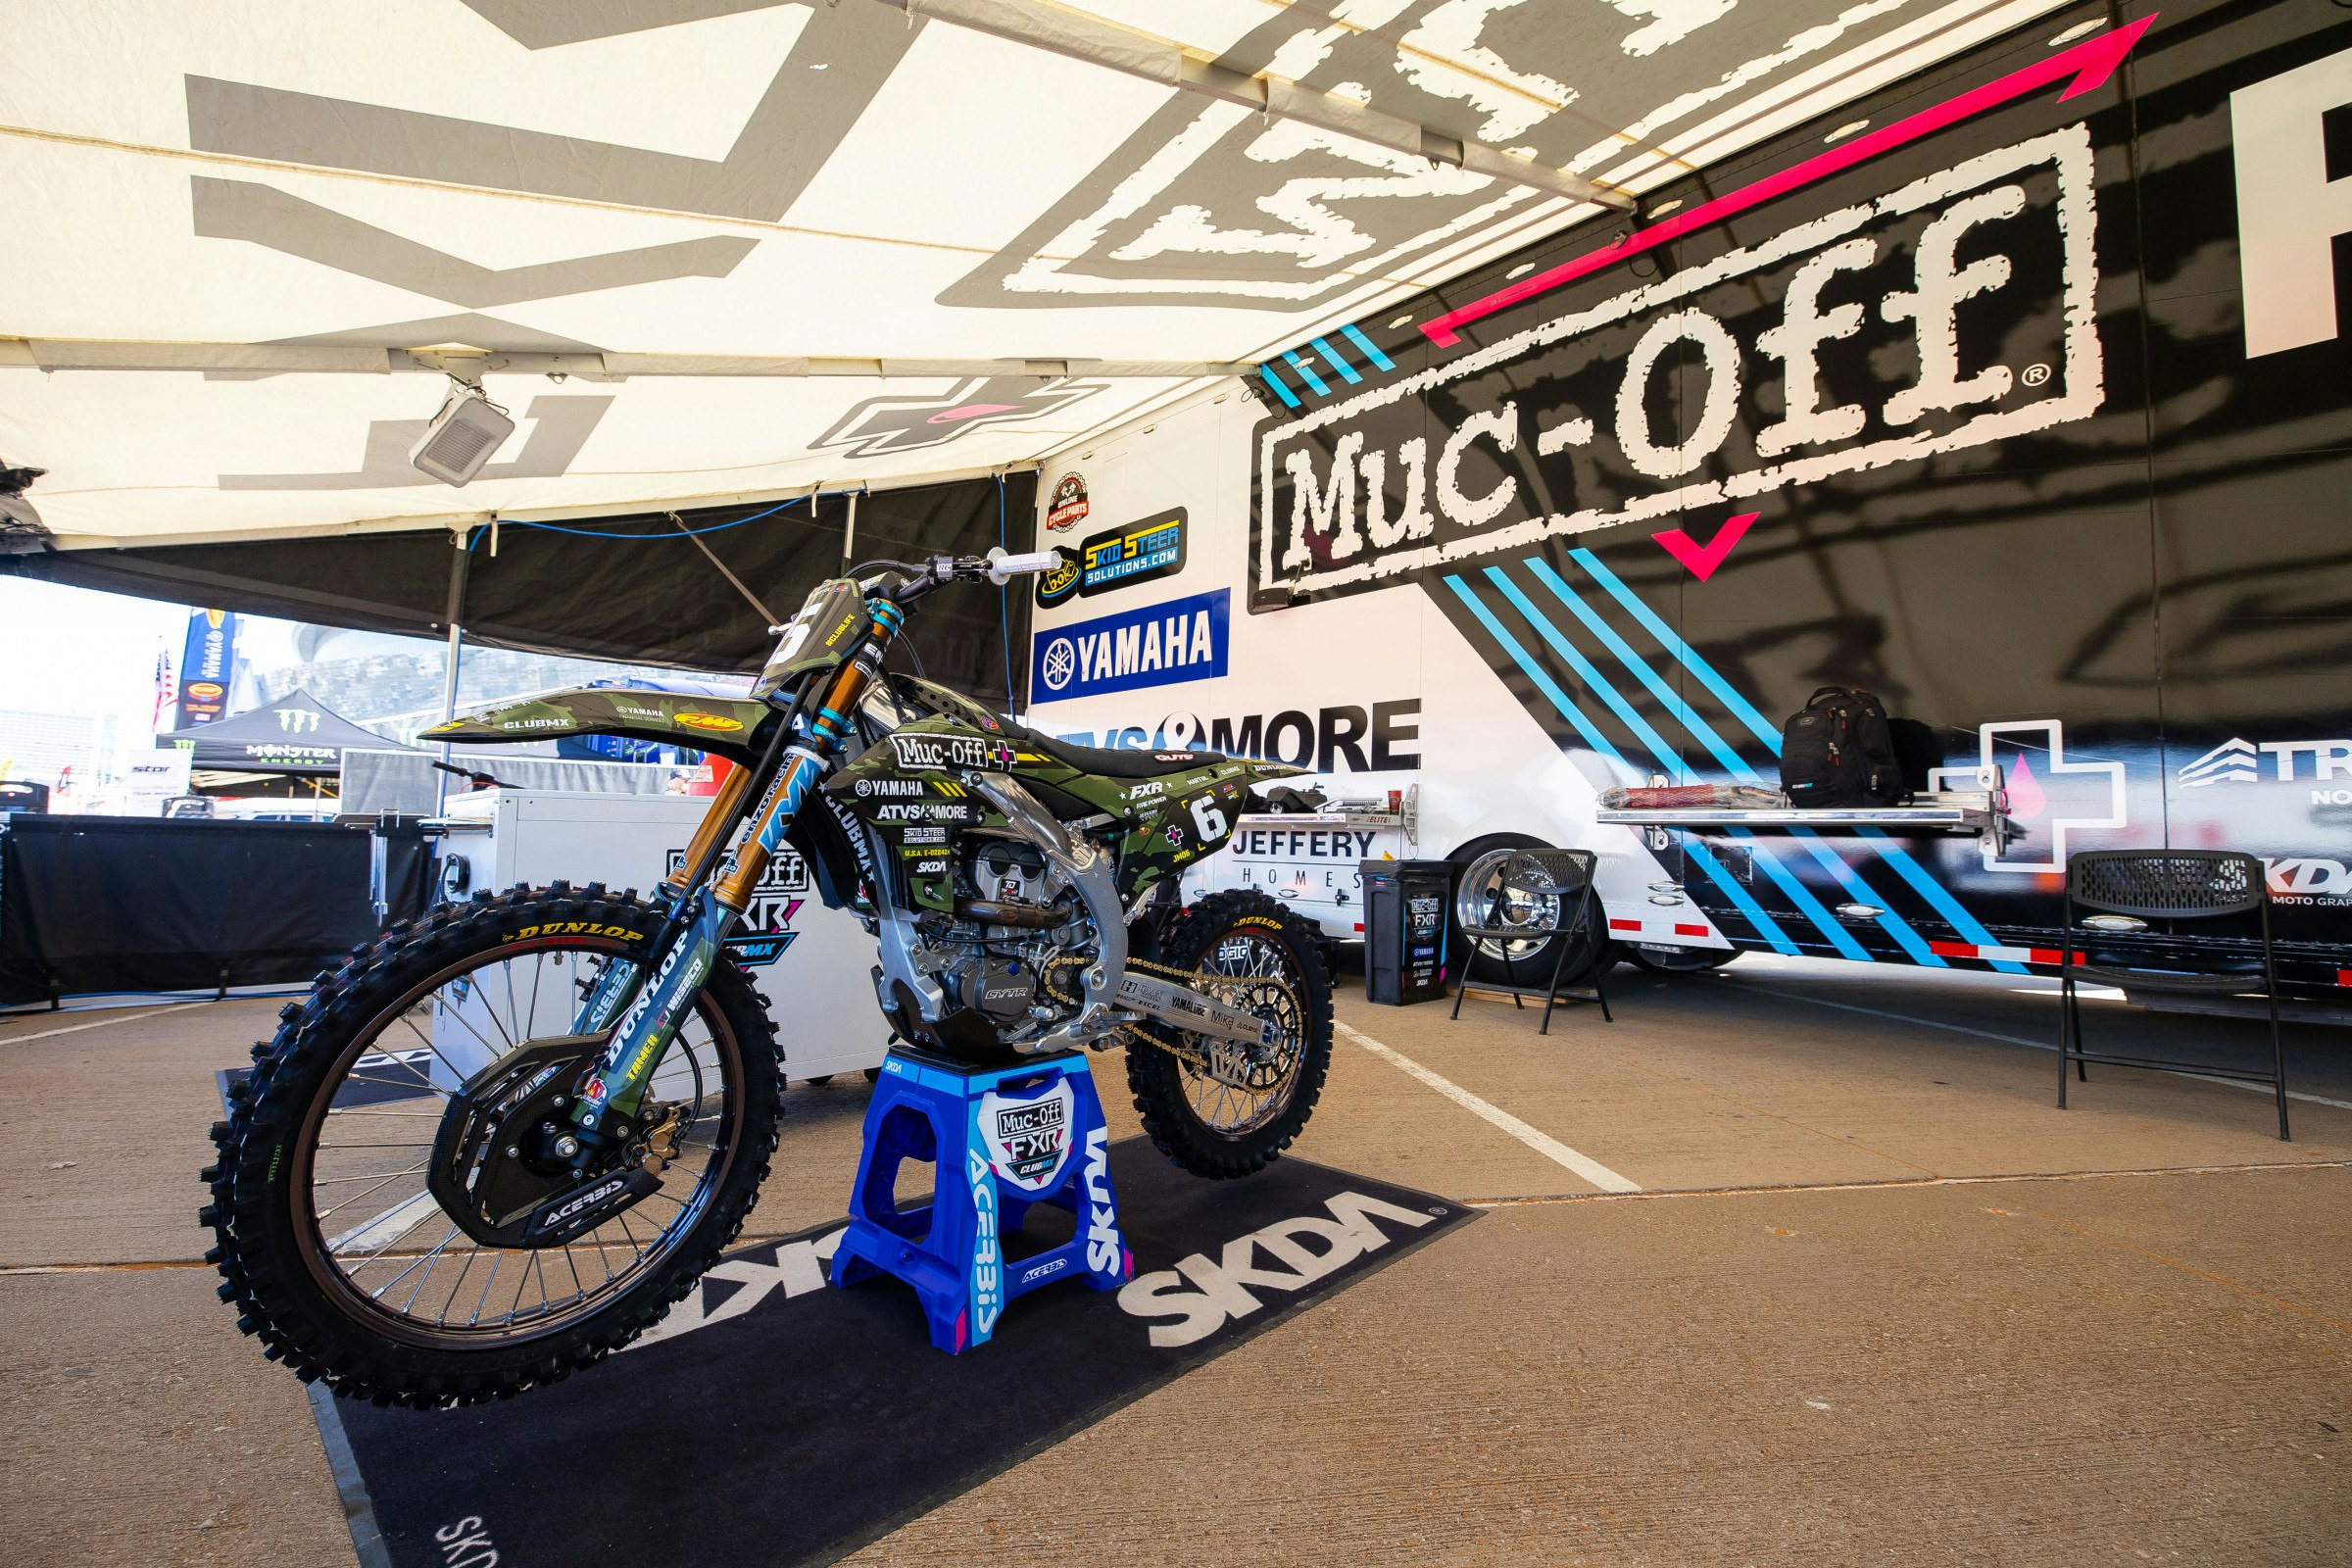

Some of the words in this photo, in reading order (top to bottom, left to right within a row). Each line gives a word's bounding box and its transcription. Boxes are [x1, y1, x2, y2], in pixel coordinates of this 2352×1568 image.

[1282, 184, 2026, 570] Muc-Off
[1057, 494, 1079, 509] ONLINE
[1087, 549, 1176, 583] SOLUTIONS.COM
[1078, 611, 1212, 683] YAMAHA
[627, 707, 664, 717] YAMAHA
[503, 718, 569, 730] CLUBMX
[246, 743, 337, 760] MONSTER
[898, 738, 987, 767] Muc-Off
[872, 780, 923, 797] YAMAHA
[1130, 781, 1163, 800] FXR
[1190, 795, 1228, 842] 6
[824, 795, 872, 872] CLUBMX
[1233, 831, 1377, 858] JEFFERY
[2272, 896, 2314, 906] MOTO
[515, 922, 644, 941] DUNLOP
[1236, 916, 1283, 930] DUNLOP
[608, 930, 688, 1067] DUNLOP
[985, 987, 1028, 1000] GYTR
[885, 1059, 902, 1074] SKDA
[1002, 1103, 1062, 1134] Muc-Off
[1009, 1128, 1061, 1161] FXR
[1019, 1157, 1054, 1175] CLUBMX
